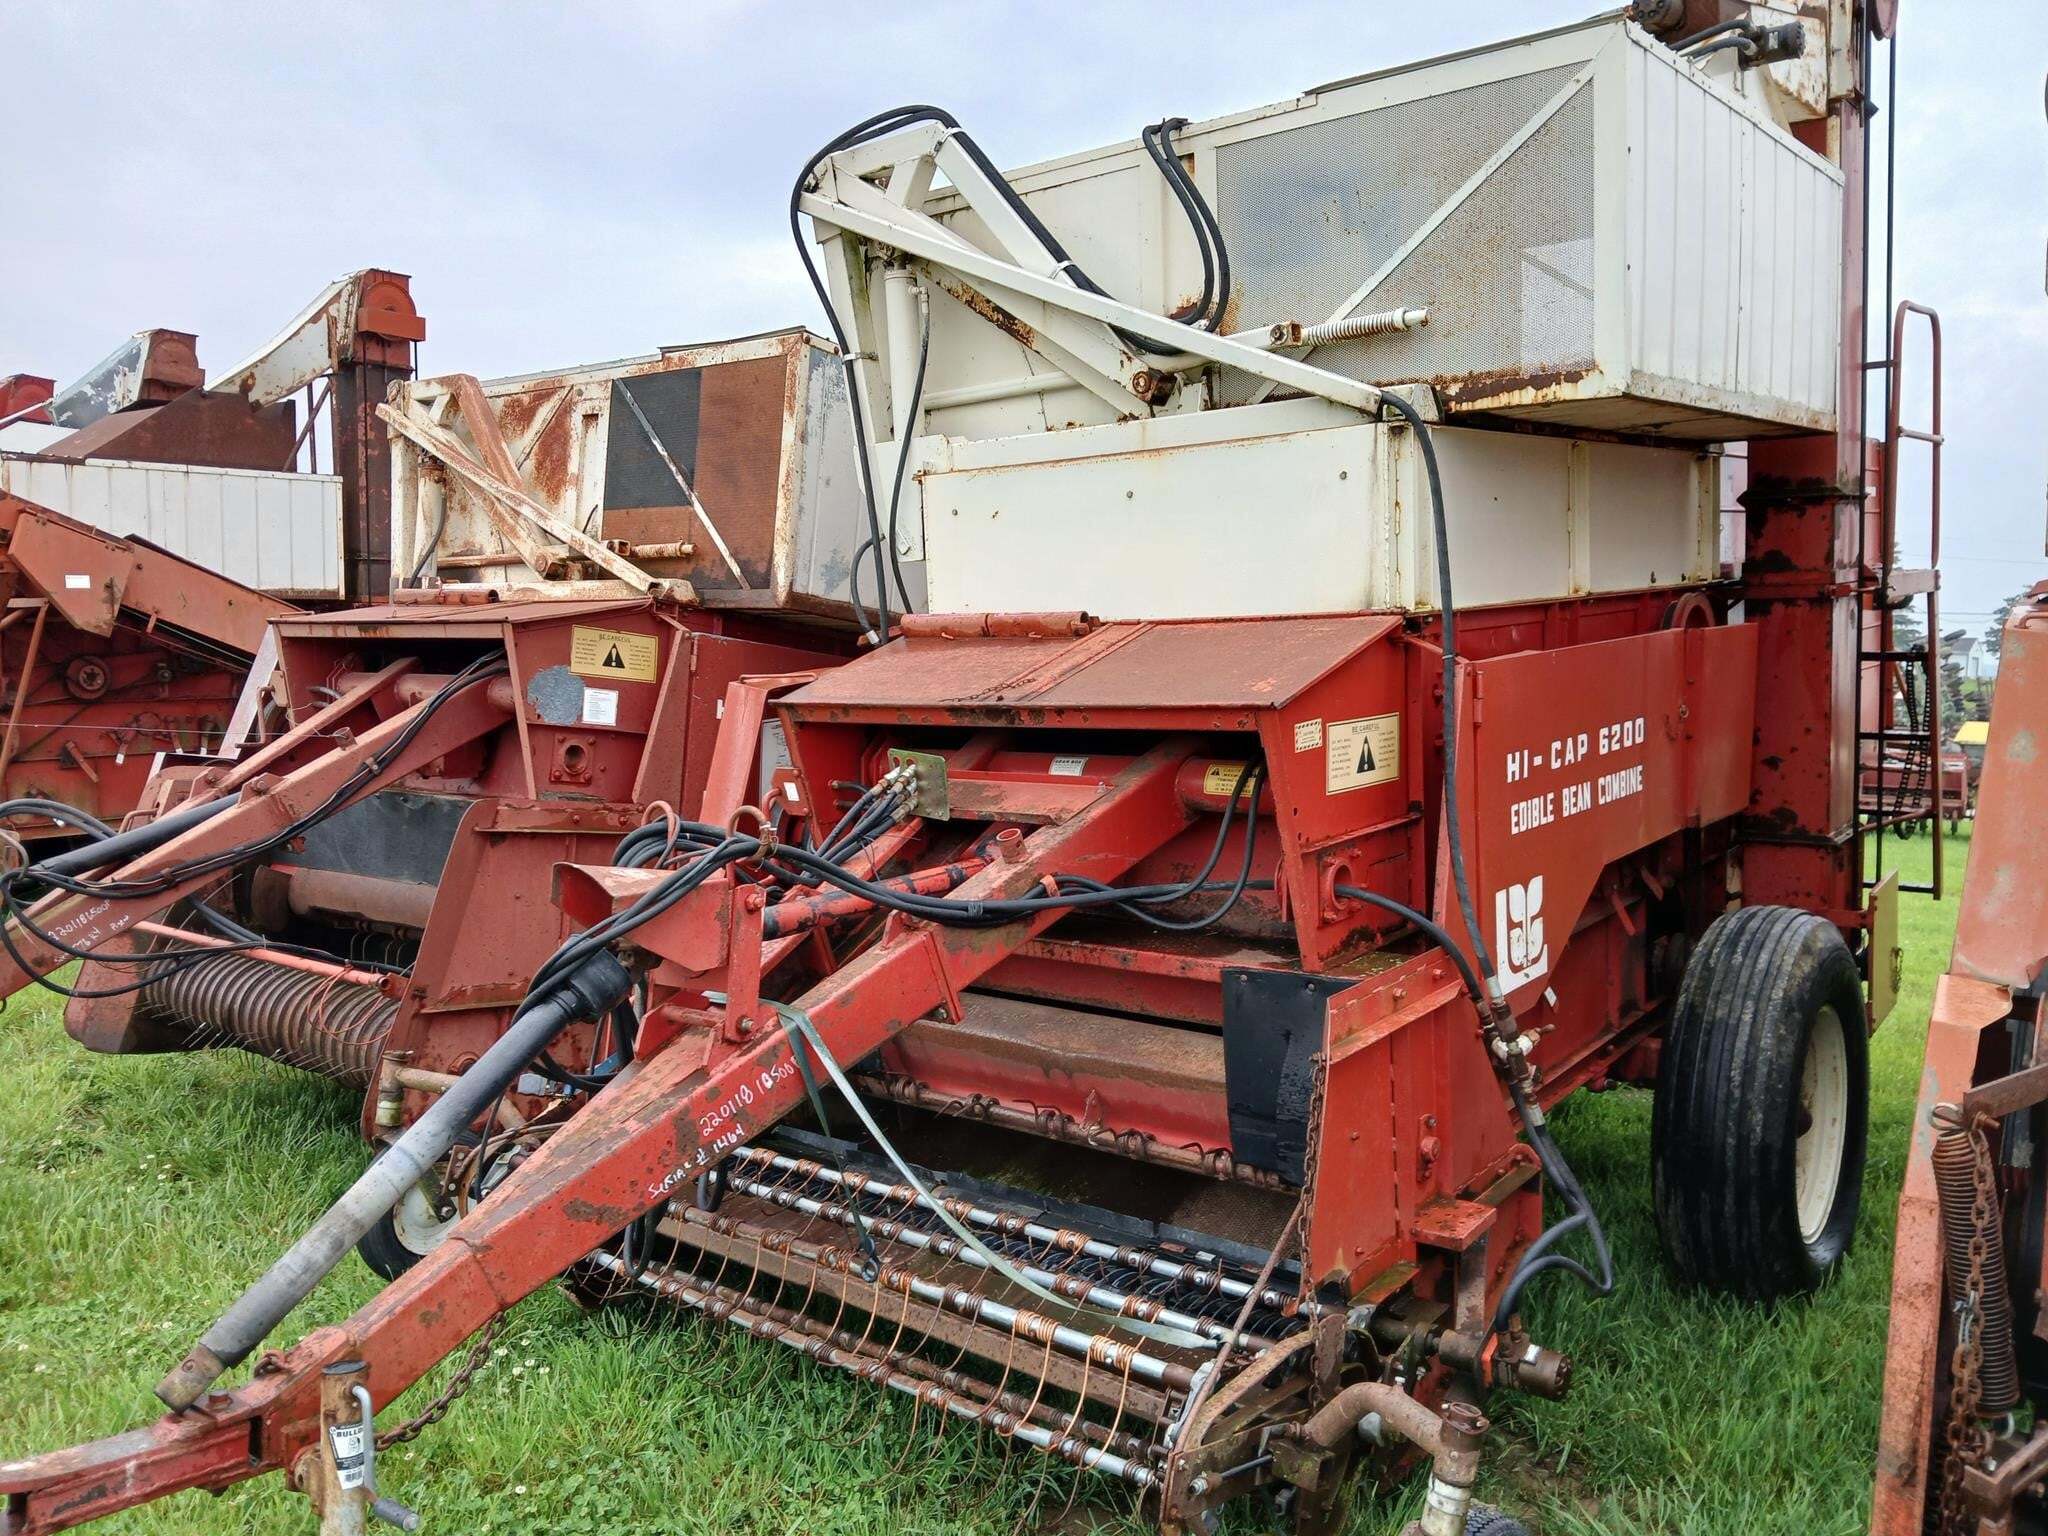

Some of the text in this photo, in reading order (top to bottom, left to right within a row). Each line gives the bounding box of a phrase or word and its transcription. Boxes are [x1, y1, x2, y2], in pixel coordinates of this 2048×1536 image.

[1599, 717, 1645, 756] 6200
[1510, 765, 1644, 836] EDIBLE BEAN COMBINE
[699, 1084, 755, 1137] 220118
[336, 1427, 363, 1437] BULLD
